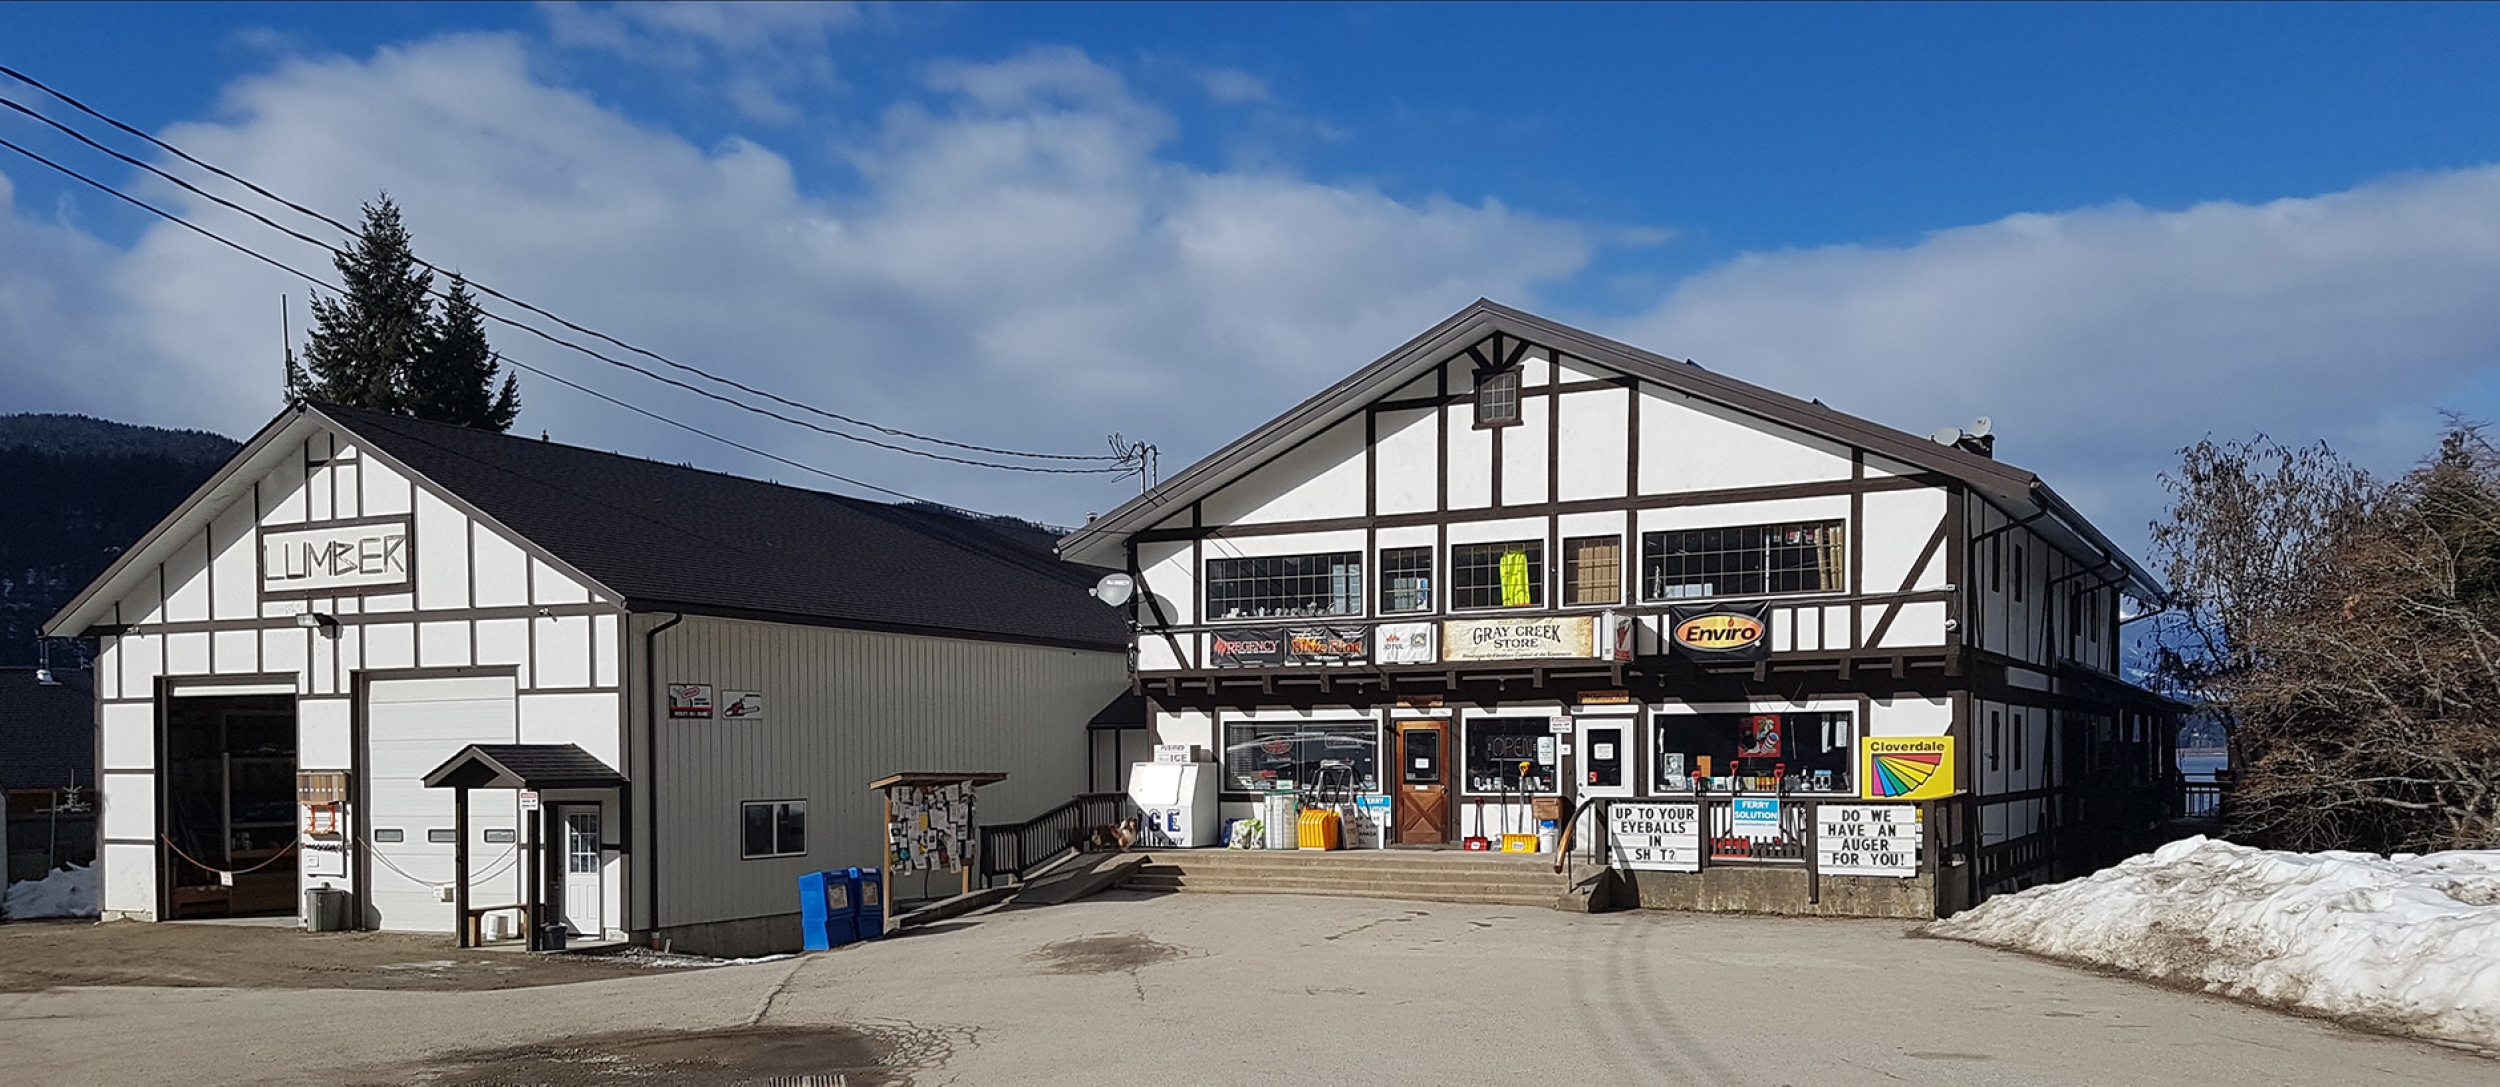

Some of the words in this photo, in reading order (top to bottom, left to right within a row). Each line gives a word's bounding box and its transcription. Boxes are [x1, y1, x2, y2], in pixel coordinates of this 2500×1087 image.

[264, 534, 406, 581] LUMBER
[1472, 626, 1511, 645] GRAY
[1515, 624, 1561, 644] CREEK
[1685, 620, 1756, 642] Enviro
[1226, 640, 1280, 654] REGENCY
[1494, 638, 1539, 649] STORE
[1493, 736, 1533, 758] OPEN
[1870, 741, 1945, 751] Cloverdale
[1169, 753, 1188, 763] ICE
[1741, 800, 1770, 809] FERRY
[1615, 808, 1633, 820] UP
[1637, 808, 1654, 820] TO
[1659, 808, 1695, 820] YOUR
[1734, 811, 1778, 819] SOLUTION
[1841, 809, 1861, 822] DO
[1870, 809, 1892, 822] WE
[1621, 821, 1686, 834] EYEBALLS
[1827, 824, 1865, 837] HAVE
[1877, 824, 1896, 837] AN
[1648, 835, 1662, 847] IN
[1841, 838, 1889, 851] AUGER
[1635, 848, 1651, 860] SH
[1832, 852, 1860, 866] FOR
[1870, 853, 1905, 866] YOU!
